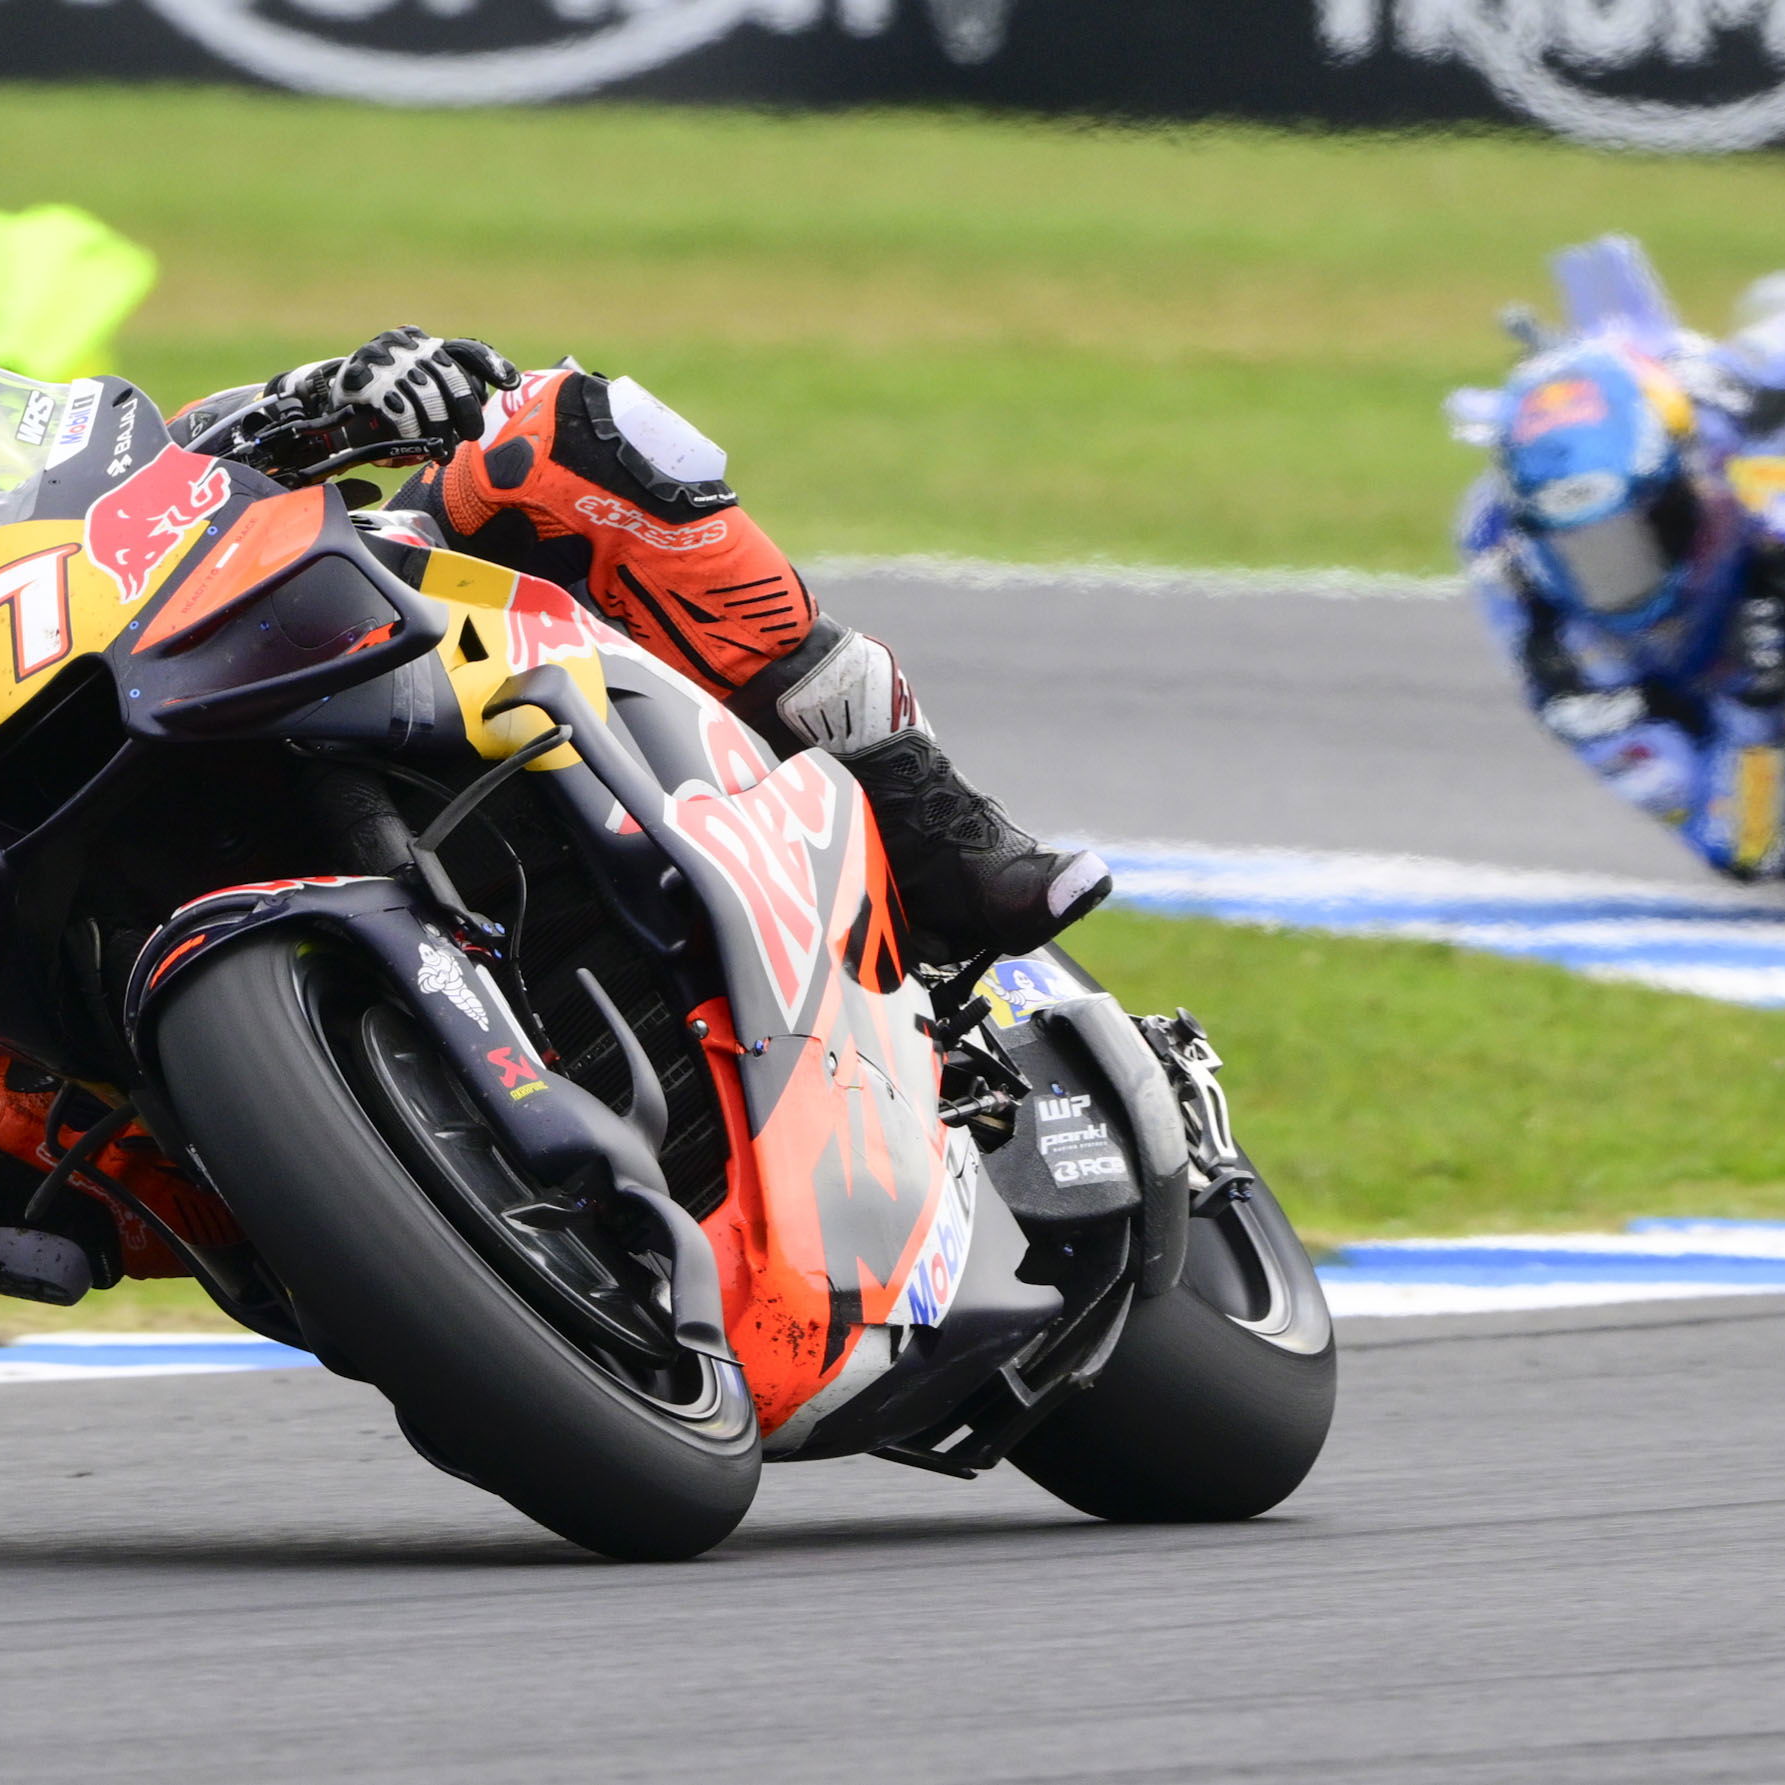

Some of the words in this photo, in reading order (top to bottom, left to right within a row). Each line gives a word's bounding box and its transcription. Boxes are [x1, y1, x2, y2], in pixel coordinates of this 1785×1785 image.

[16, 390, 53, 446] WRS
[59, 408, 92, 445] Mobil
[114, 398, 138, 456] BAJAJ
[575, 496, 728, 551] alpinestars
[1038, 1094, 1092, 1122] WP
[1040, 1123, 1108, 1156] pankl
[907, 1178, 965, 1326] Mobil
